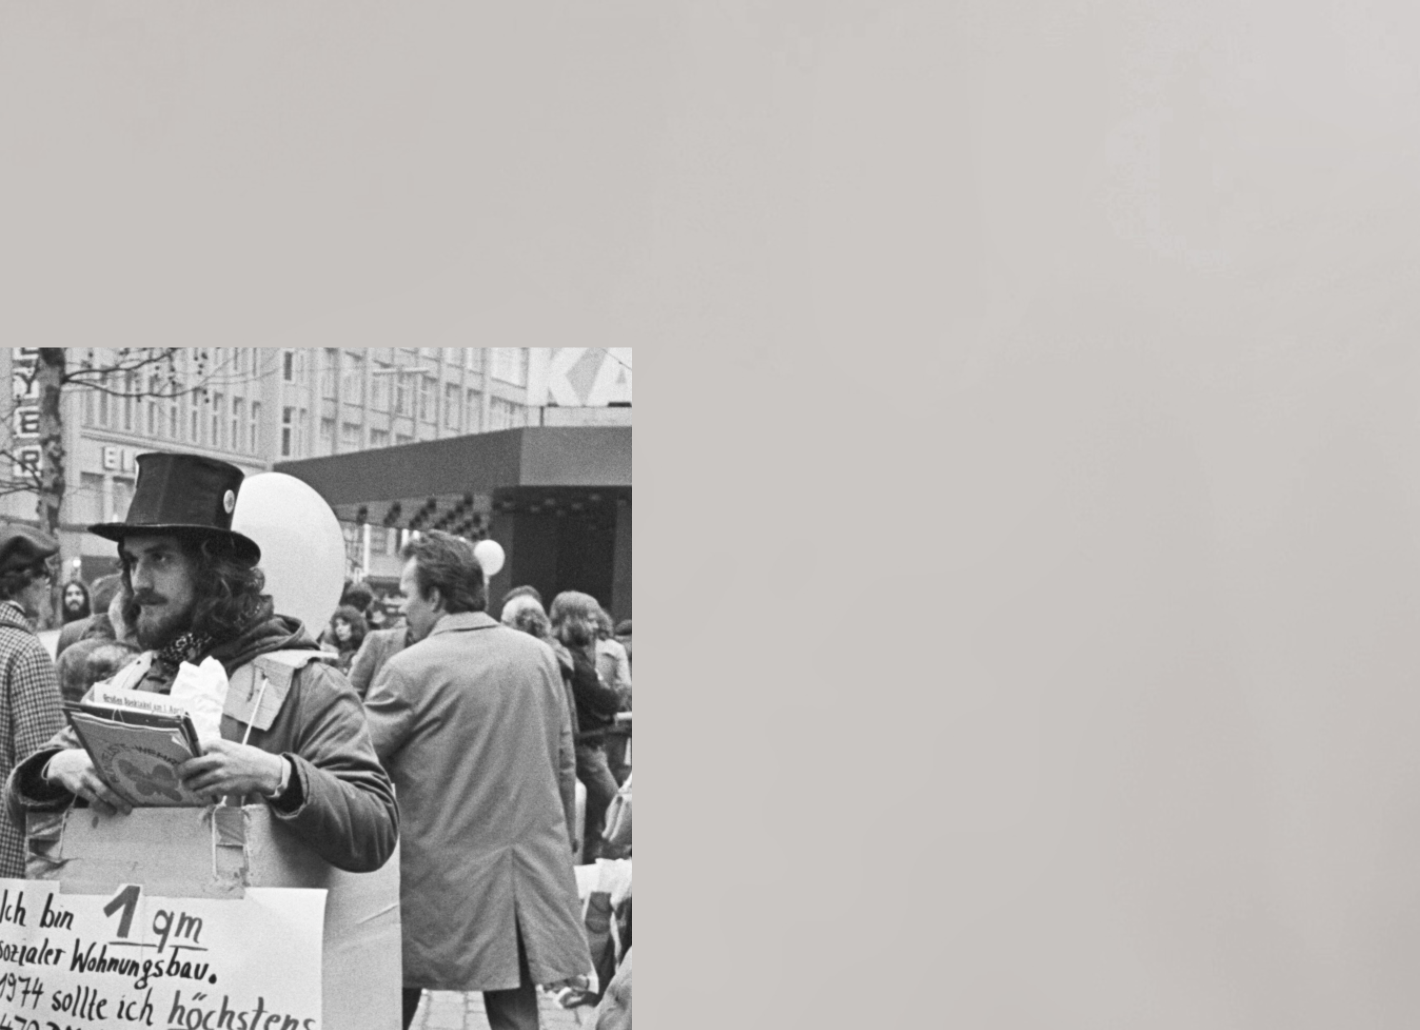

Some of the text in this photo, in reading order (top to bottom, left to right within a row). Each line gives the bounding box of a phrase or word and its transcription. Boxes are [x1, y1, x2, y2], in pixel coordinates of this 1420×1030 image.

[39, 893, 75, 931] bin
[102, 885, 141, 939] 1
[152, 909, 203, 954] qm
[69, 938, 218, 991] Wohnungsbau.
[51, 985, 108, 1021] sollte
[116, 986, 154, 1027] ich
